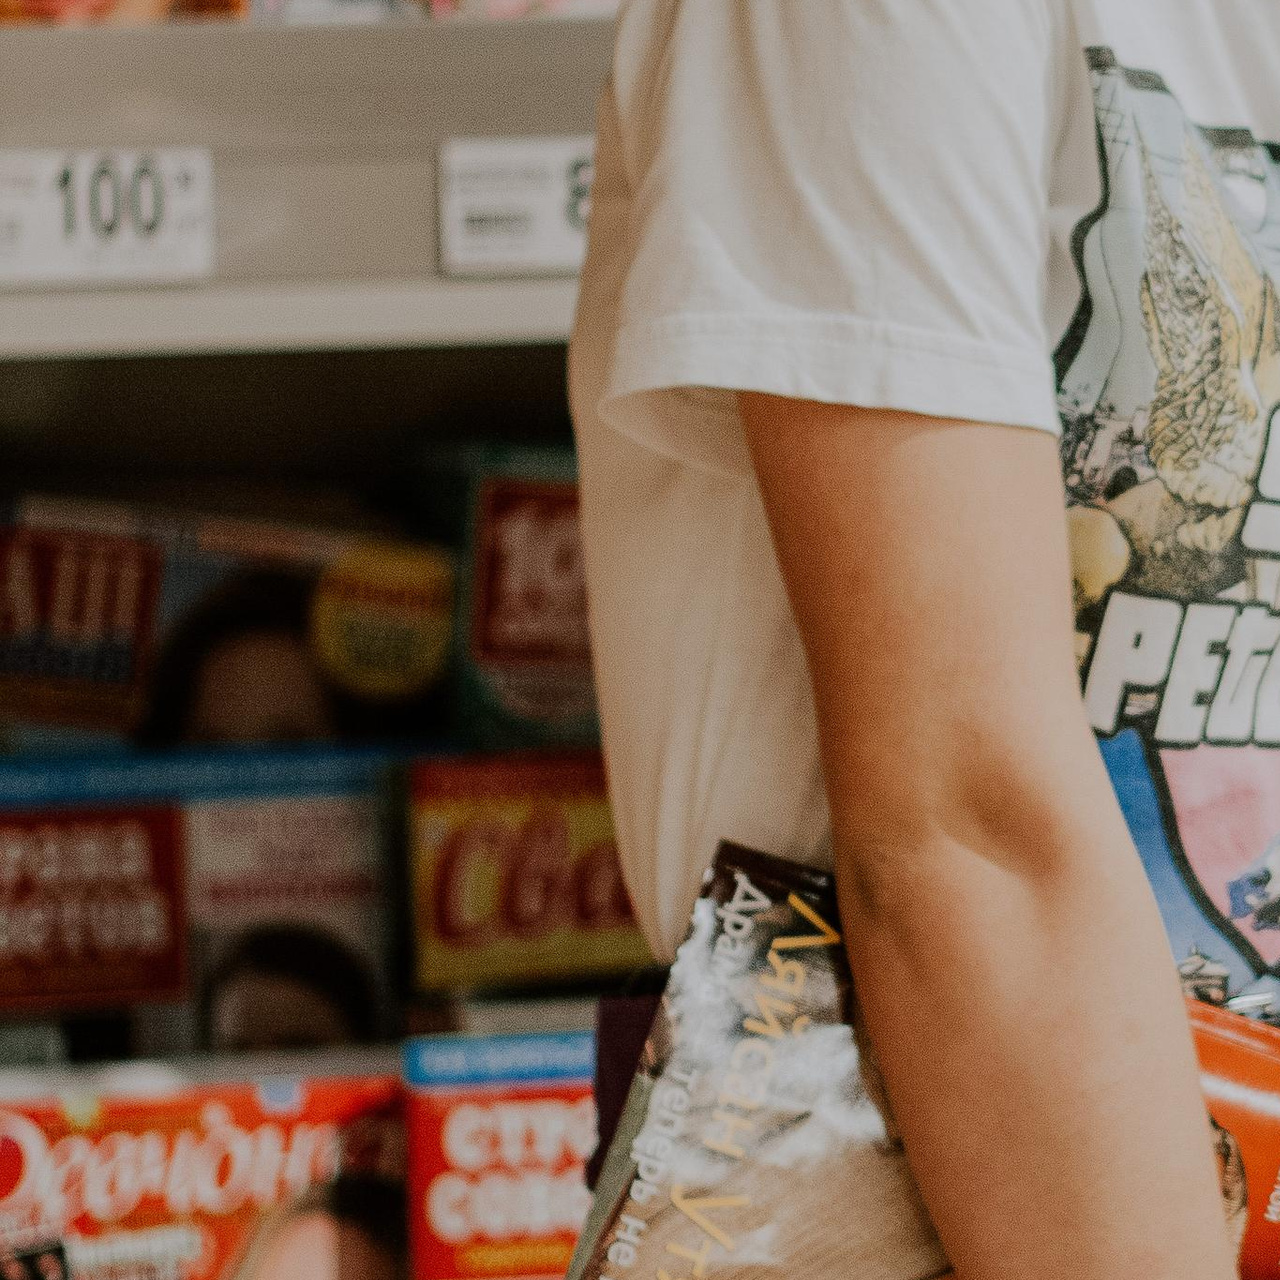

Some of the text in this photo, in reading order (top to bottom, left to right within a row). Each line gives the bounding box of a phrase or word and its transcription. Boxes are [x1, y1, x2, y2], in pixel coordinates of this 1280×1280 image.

[56, 158, 165, 238] 100
[705, 895, 844, 1156] Ляйсан
[618, 1062, 695, 1204] теперь
[606, 1214, 645, 1267] не
